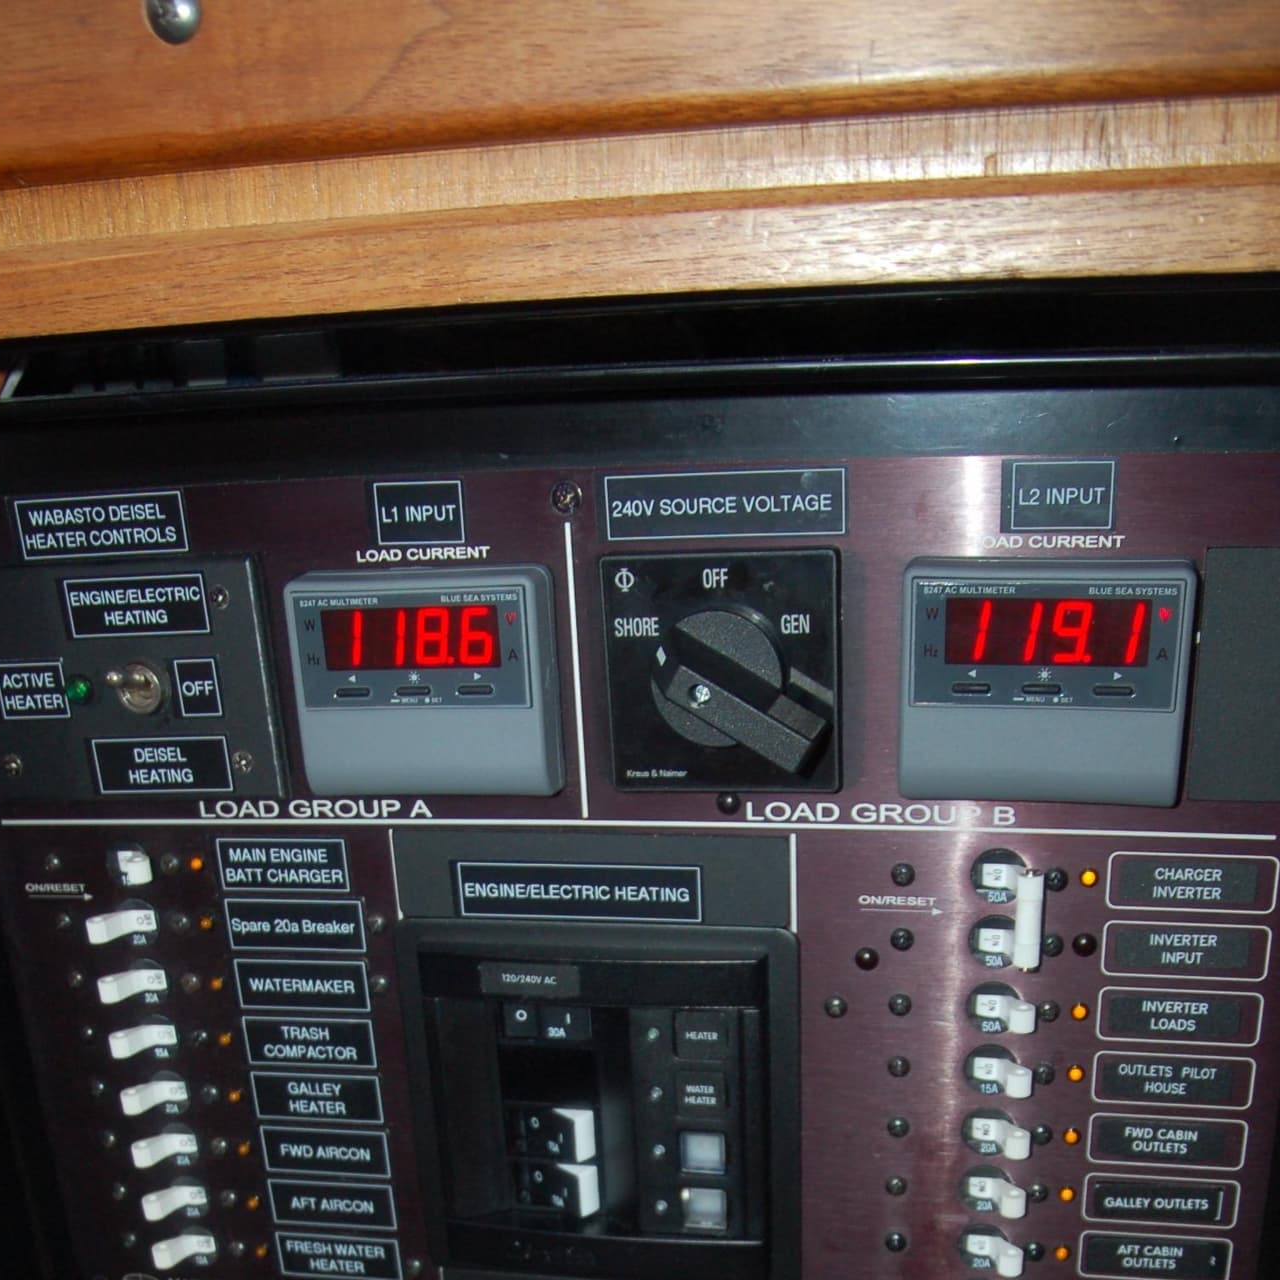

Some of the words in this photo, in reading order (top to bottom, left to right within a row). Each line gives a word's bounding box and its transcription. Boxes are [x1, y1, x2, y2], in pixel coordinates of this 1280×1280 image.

[1019, 487, 1040, 505] L2
[1046, 488, 1105, 506] INPUT
[612, 498, 655, 518] 240V
[659, 495, 737, 515] SOURCE
[741, 492, 832, 512] VOLTAGE
[29, 507, 106, 526] WABASTO
[109, 504, 166, 522] DEISEL
[382, 507, 401, 523] L1
[405, 504, 456, 522] INPUT
[25, 530, 85, 549] HEATER
[89, 526, 176, 546] CONTROLS
[1028, 535, 1126, 548] CURRENT
[356, 549, 401, 562] LOAD
[406, 546, 489, 560] CURRENT
[703, 569, 727, 588] OFF
[71, 586, 200, 607] ENGINE/ELECTRIC
[480, 593, 517, 601] SYSTEMS
[945, 586, 958, 594] AC
[1089, 587, 1113, 595] BLUE
[1114, 587, 1134, 595] SEA
[330, 597, 378, 605] MULTIMETER
[104, 608, 168, 626] HEATING
[781, 615, 809, 635] GEN
[615, 617, 659, 638] SHORE
[973, 599, 1145, 664] 119.1
[352, 607, 494, 667] 118.6
[3, 672, 54, 689] ACTIVE
[182, 680, 213, 698] OFF
[5, 694, 64, 712] HEATER
[133, 747, 187, 764] DEISEL
[129, 766, 193, 784] HEATING
[199, 799, 280, 817] LOAD
[288, 799, 403, 817] GROUP
[409, 799, 432, 817] A
[746, 802, 840, 822] LOAD
[851, 803, 982, 824] GROUP
[993, 806, 1015, 825] B
[229, 848, 267, 863] MAIN
[270, 848, 327, 863] ENGINE
[226, 867, 266, 883] BATT
[269, 867, 343, 884] CHARGER
[1154, 867, 1221, 882] CHARGER
[25, 883, 85, 892] ON/RESET
[464, 882, 610, 901] ENGINE/ELECTRIC
[614, 886, 689, 903] HEATING
[1152, 885, 1221, 900] INVERTER
[858, 896, 936, 906] ON/RESET
[988, 890, 1007, 902] 50A
[231, 918, 271, 937] Spare
[274, 919, 300, 934] 20a
[301, 919, 355, 935] Breaker
[1149, 933, 1217, 948] INVERTER
[985, 955, 1003, 967] 50A
[1161, 951, 1204, 964] INPUT
[249, 977, 355, 994] WATERMAKER
[544, 975, 557, 985] AC
[1141, 1000, 1209, 1015] INVERTER
[982, 1020, 1001, 1032] 50A
[1150, 1018, 1196, 1031] LOADS
[281, 1026, 329, 1041] TRASH
[686, 1032, 718, 1040] HEATER
[264, 1043, 357, 1061] COMPACTOR
[1118, 1064, 1173, 1078] OUTLETS
[1181, 1066, 1217, 1080] PILOT
[288, 1082, 342, 1096] GALLEY
[1144, 1081, 1186, 1094] HOUSE
[289, 1100, 346, 1115] HEATER
[1125, 1127, 1155, 1141] FWD
[1158, 1128, 1197, 1142] CABIN
[281, 1144, 314, 1159] FWD
[316, 1145, 370, 1162] AIRCON
[1132, 1140, 1188, 1154] OUTLETS
[291, 1196, 317, 1211] AFT
[321, 1197, 374, 1215] AIRCON
[1104, 1196, 1151, 1210] GALLEY
[1154, 1196, 1209, 1211] OUTLETS
[287, 1240, 331, 1256] FRESH
[335, 1242, 385, 1258] WATER
[1117, 1244, 1140, 1256] AFT
[1144, 1246, 1183, 1259] CABIN
[310, 1258, 365, 1274] HEATER
[1123, 1255, 1177, 1269] OUTLETS
